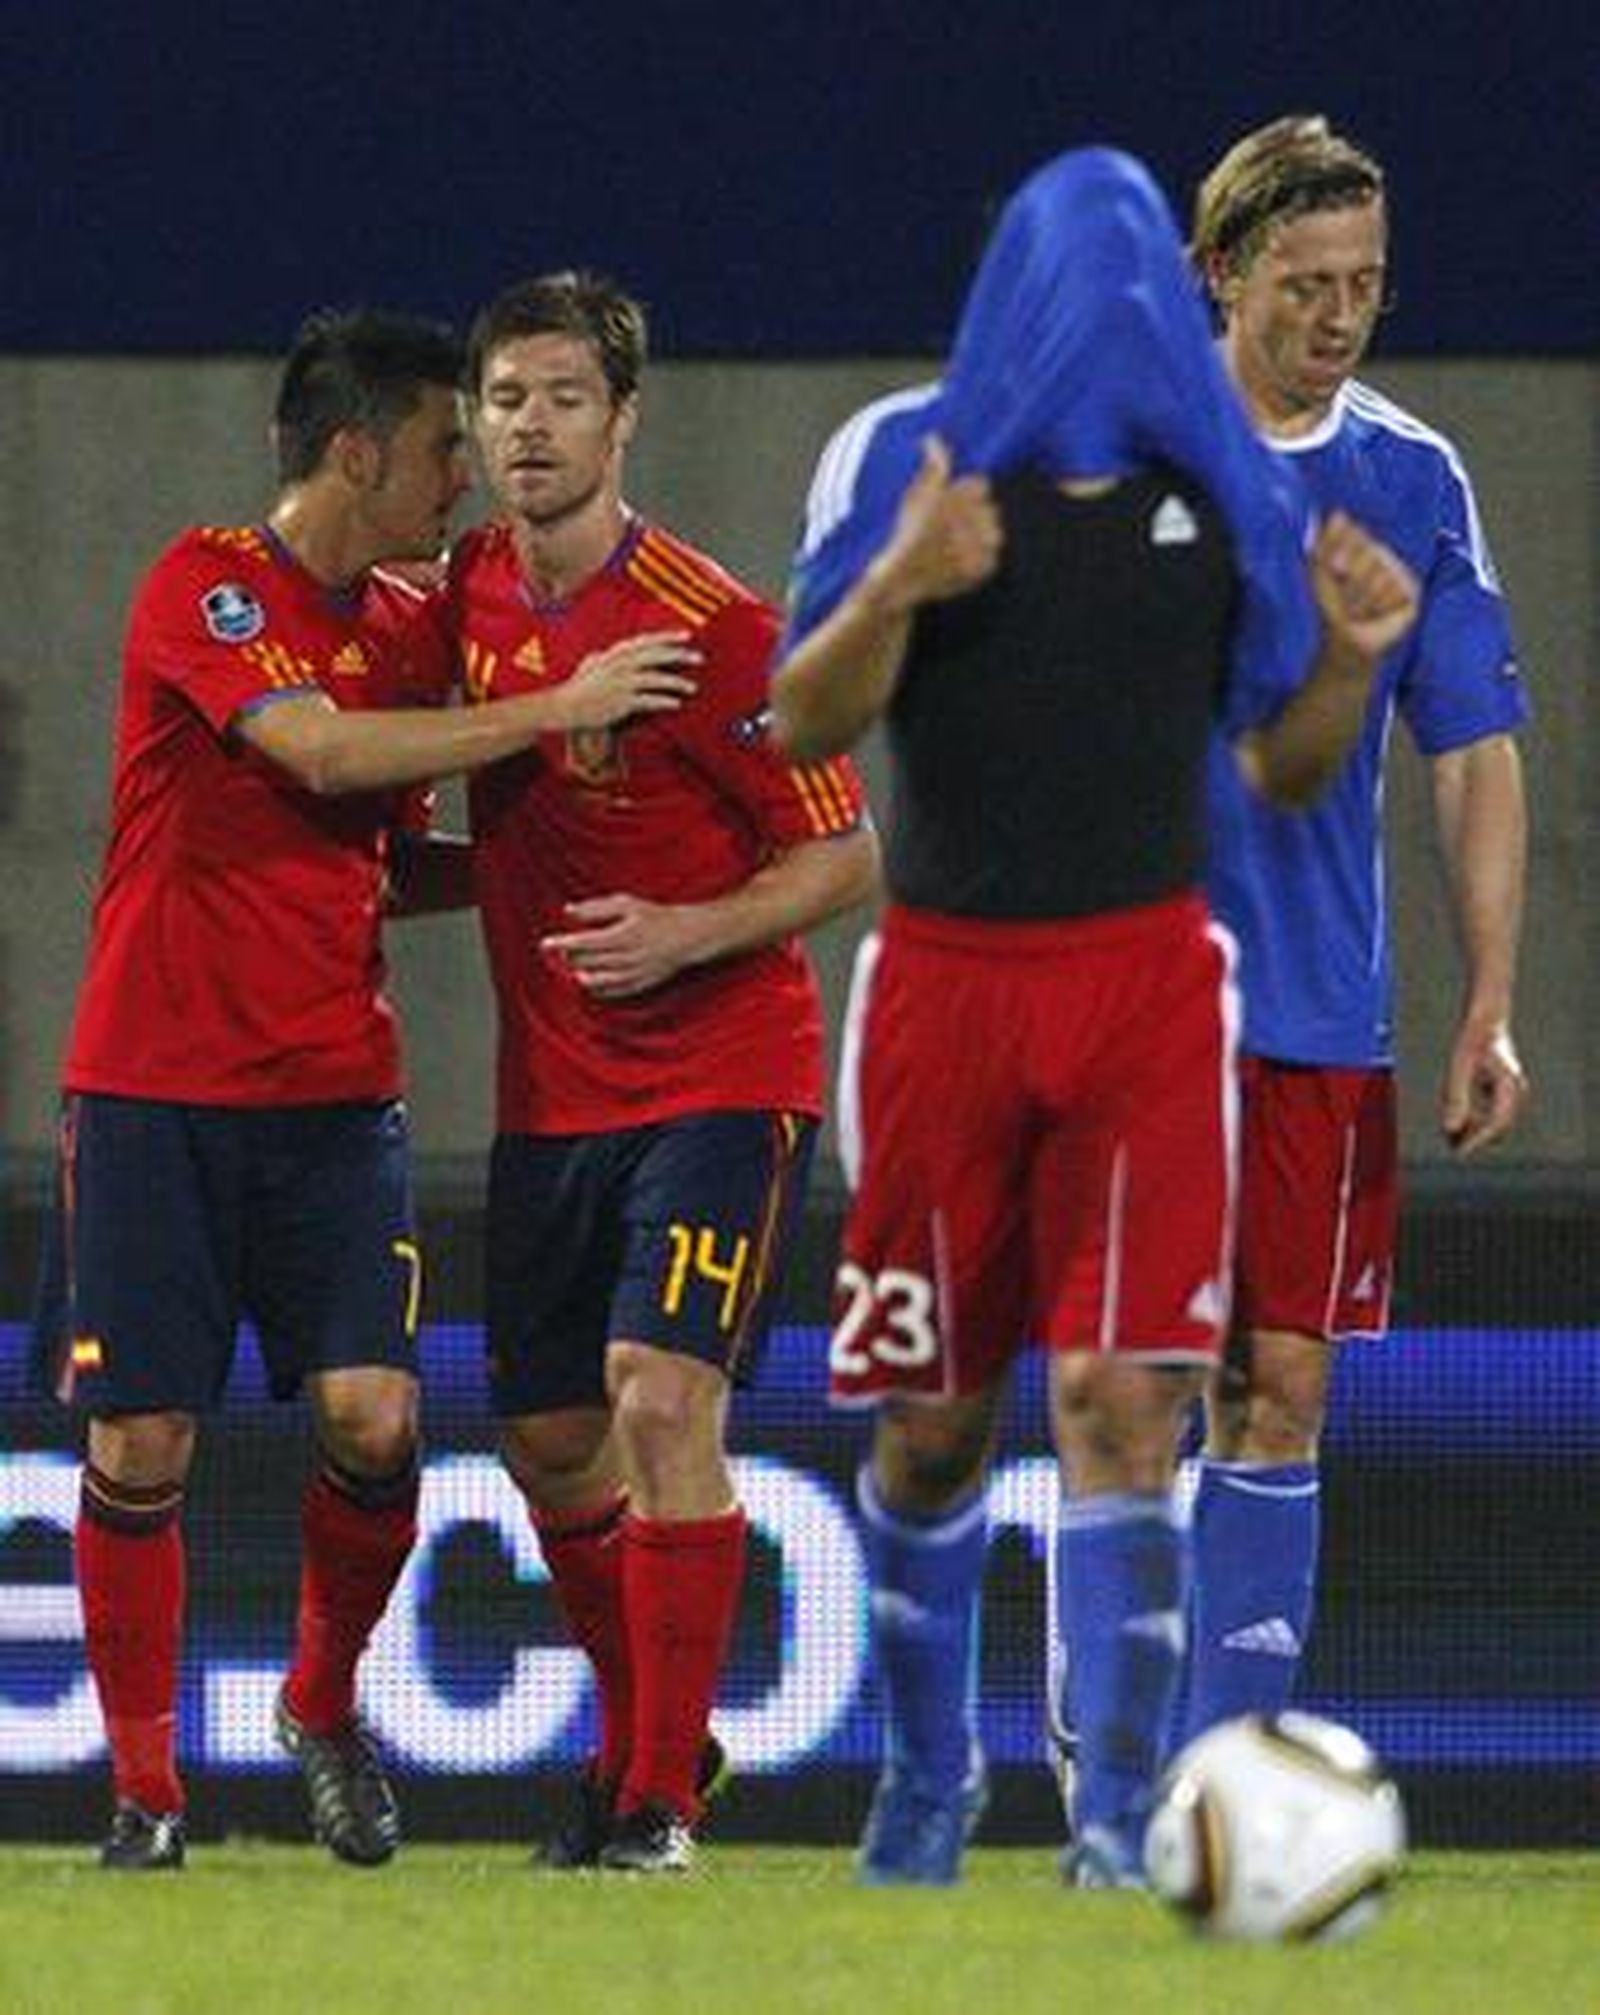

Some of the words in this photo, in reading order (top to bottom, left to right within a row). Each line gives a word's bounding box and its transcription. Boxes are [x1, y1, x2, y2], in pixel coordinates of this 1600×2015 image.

[392, 1240, 421, 1338] 7
[663, 1223, 750, 1332] 14
[829, 1261, 937, 1374] 23
